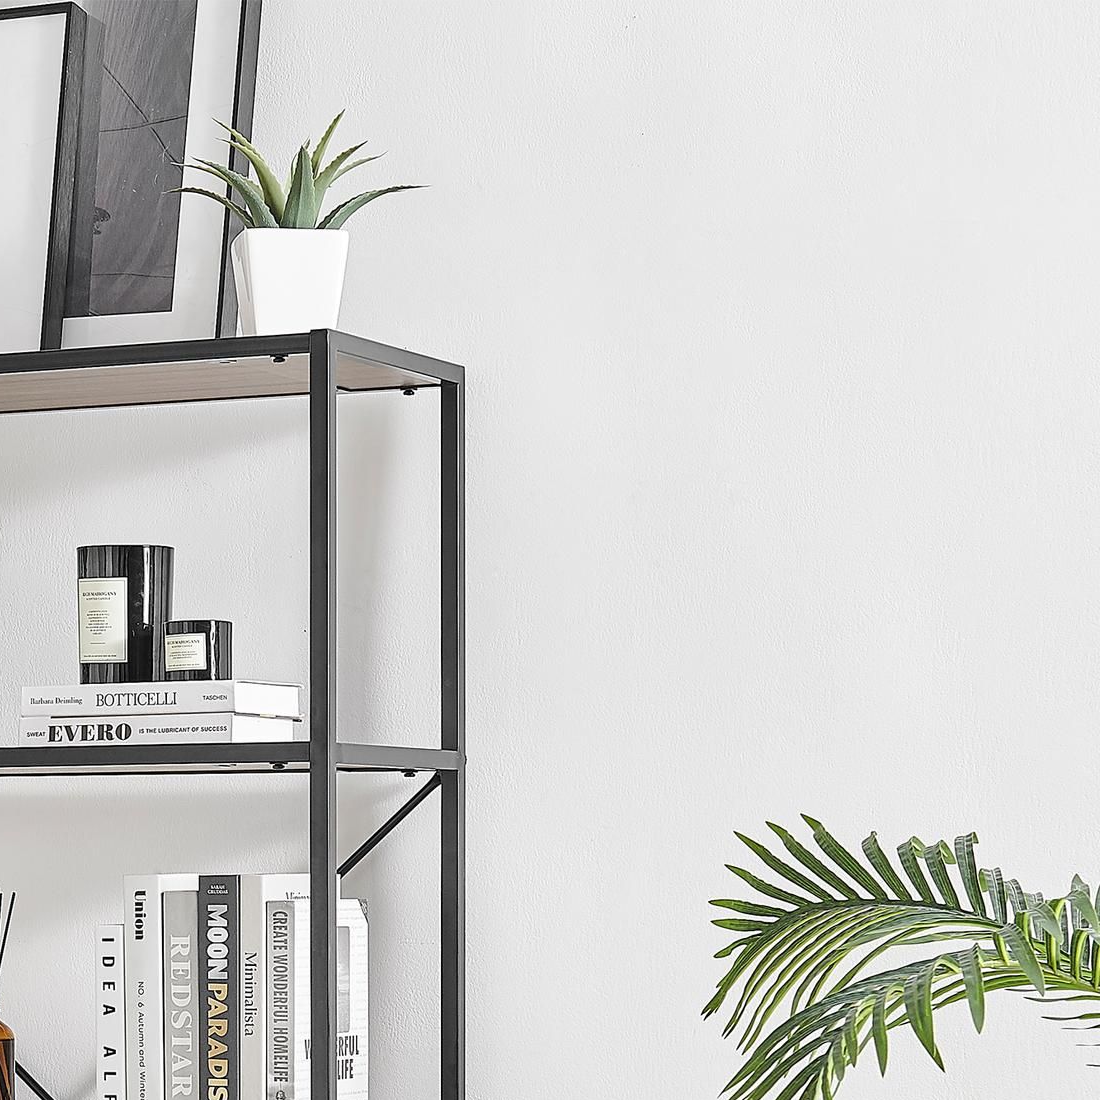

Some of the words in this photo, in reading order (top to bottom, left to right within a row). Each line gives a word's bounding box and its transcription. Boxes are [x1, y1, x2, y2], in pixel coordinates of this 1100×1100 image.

[96, 692, 177, 706] BOTTICELLI
[47, 723, 132, 742] EVERO
[134, 890, 147, 940] Union
[206, 904, 229, 980] MOON
[272, 911, 288, 950] CREATE
[102, 938, 116, 1016] IDEA
[244, 952, 258, 1036] Minimalista
[273, 954, 288, 1025] WONDERFUL
[170, 934, 194, 1098] REDSTAR
[274, 1028, 288, 1083] HOMELIFE
